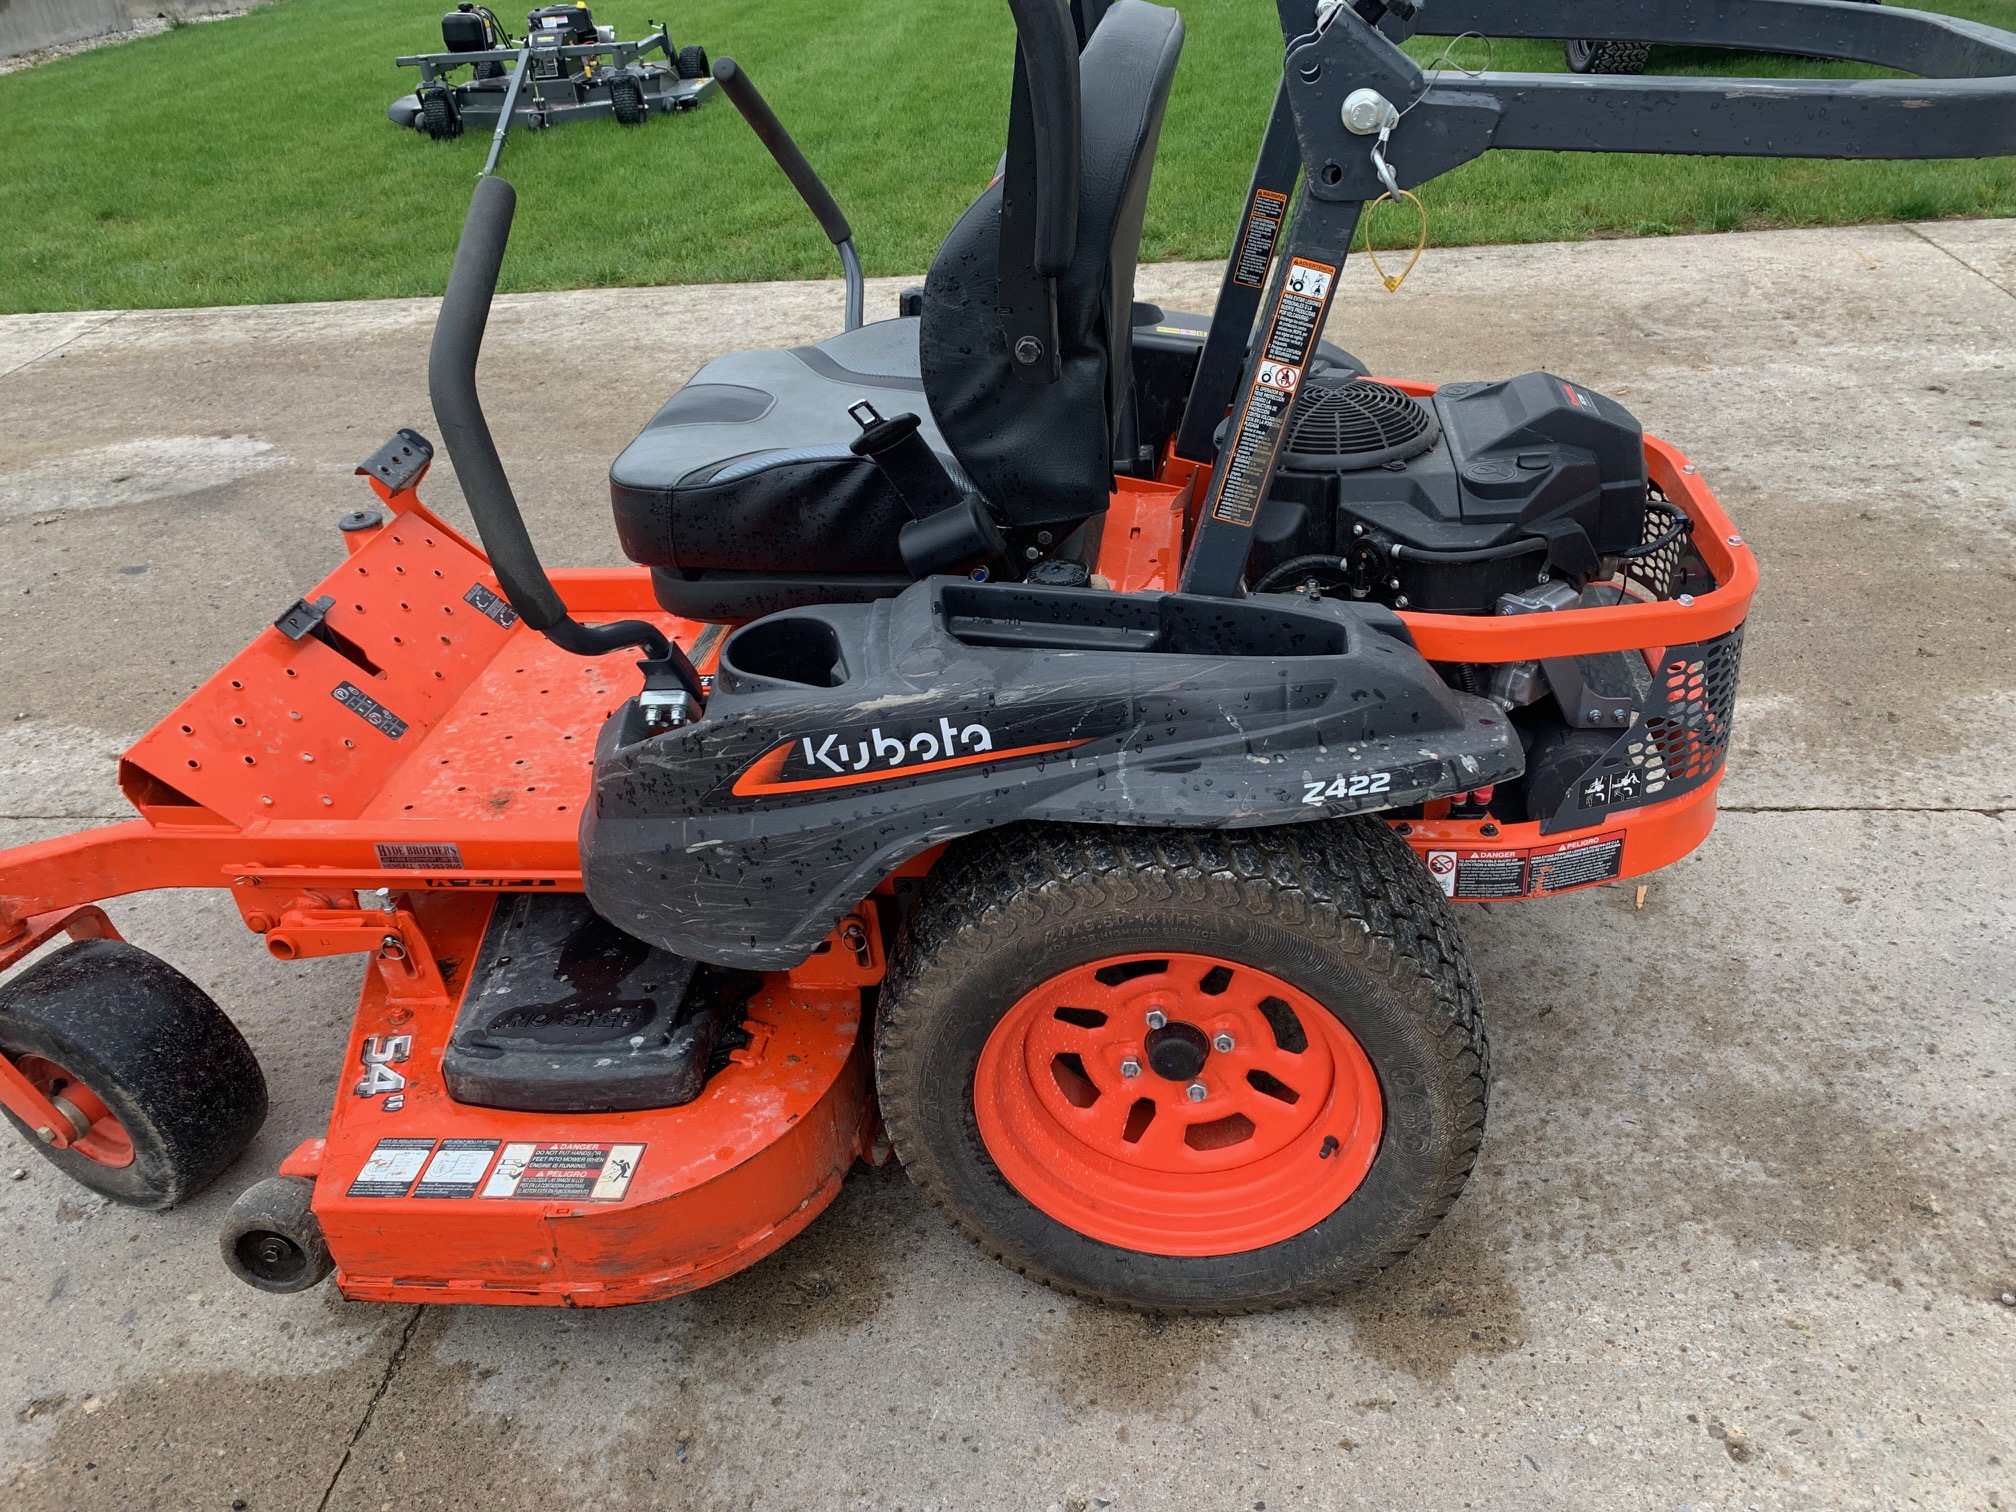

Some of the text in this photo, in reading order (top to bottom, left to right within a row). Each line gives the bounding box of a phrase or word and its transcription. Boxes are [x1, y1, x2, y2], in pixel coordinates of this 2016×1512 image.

[1262, 191, 1285, 200] WARNING
[1298, 260, 1334, 272] ADVERTENCIA
[802, 717, 993, 773] Kubota
[1302, 772, 1391, 803] Z422
[376, 845, 458, 855] HYDE BROTHERS
[1567, 837, 1600, 850] PELIGRO
[509, 1012, 637, 1029] NO STEP
